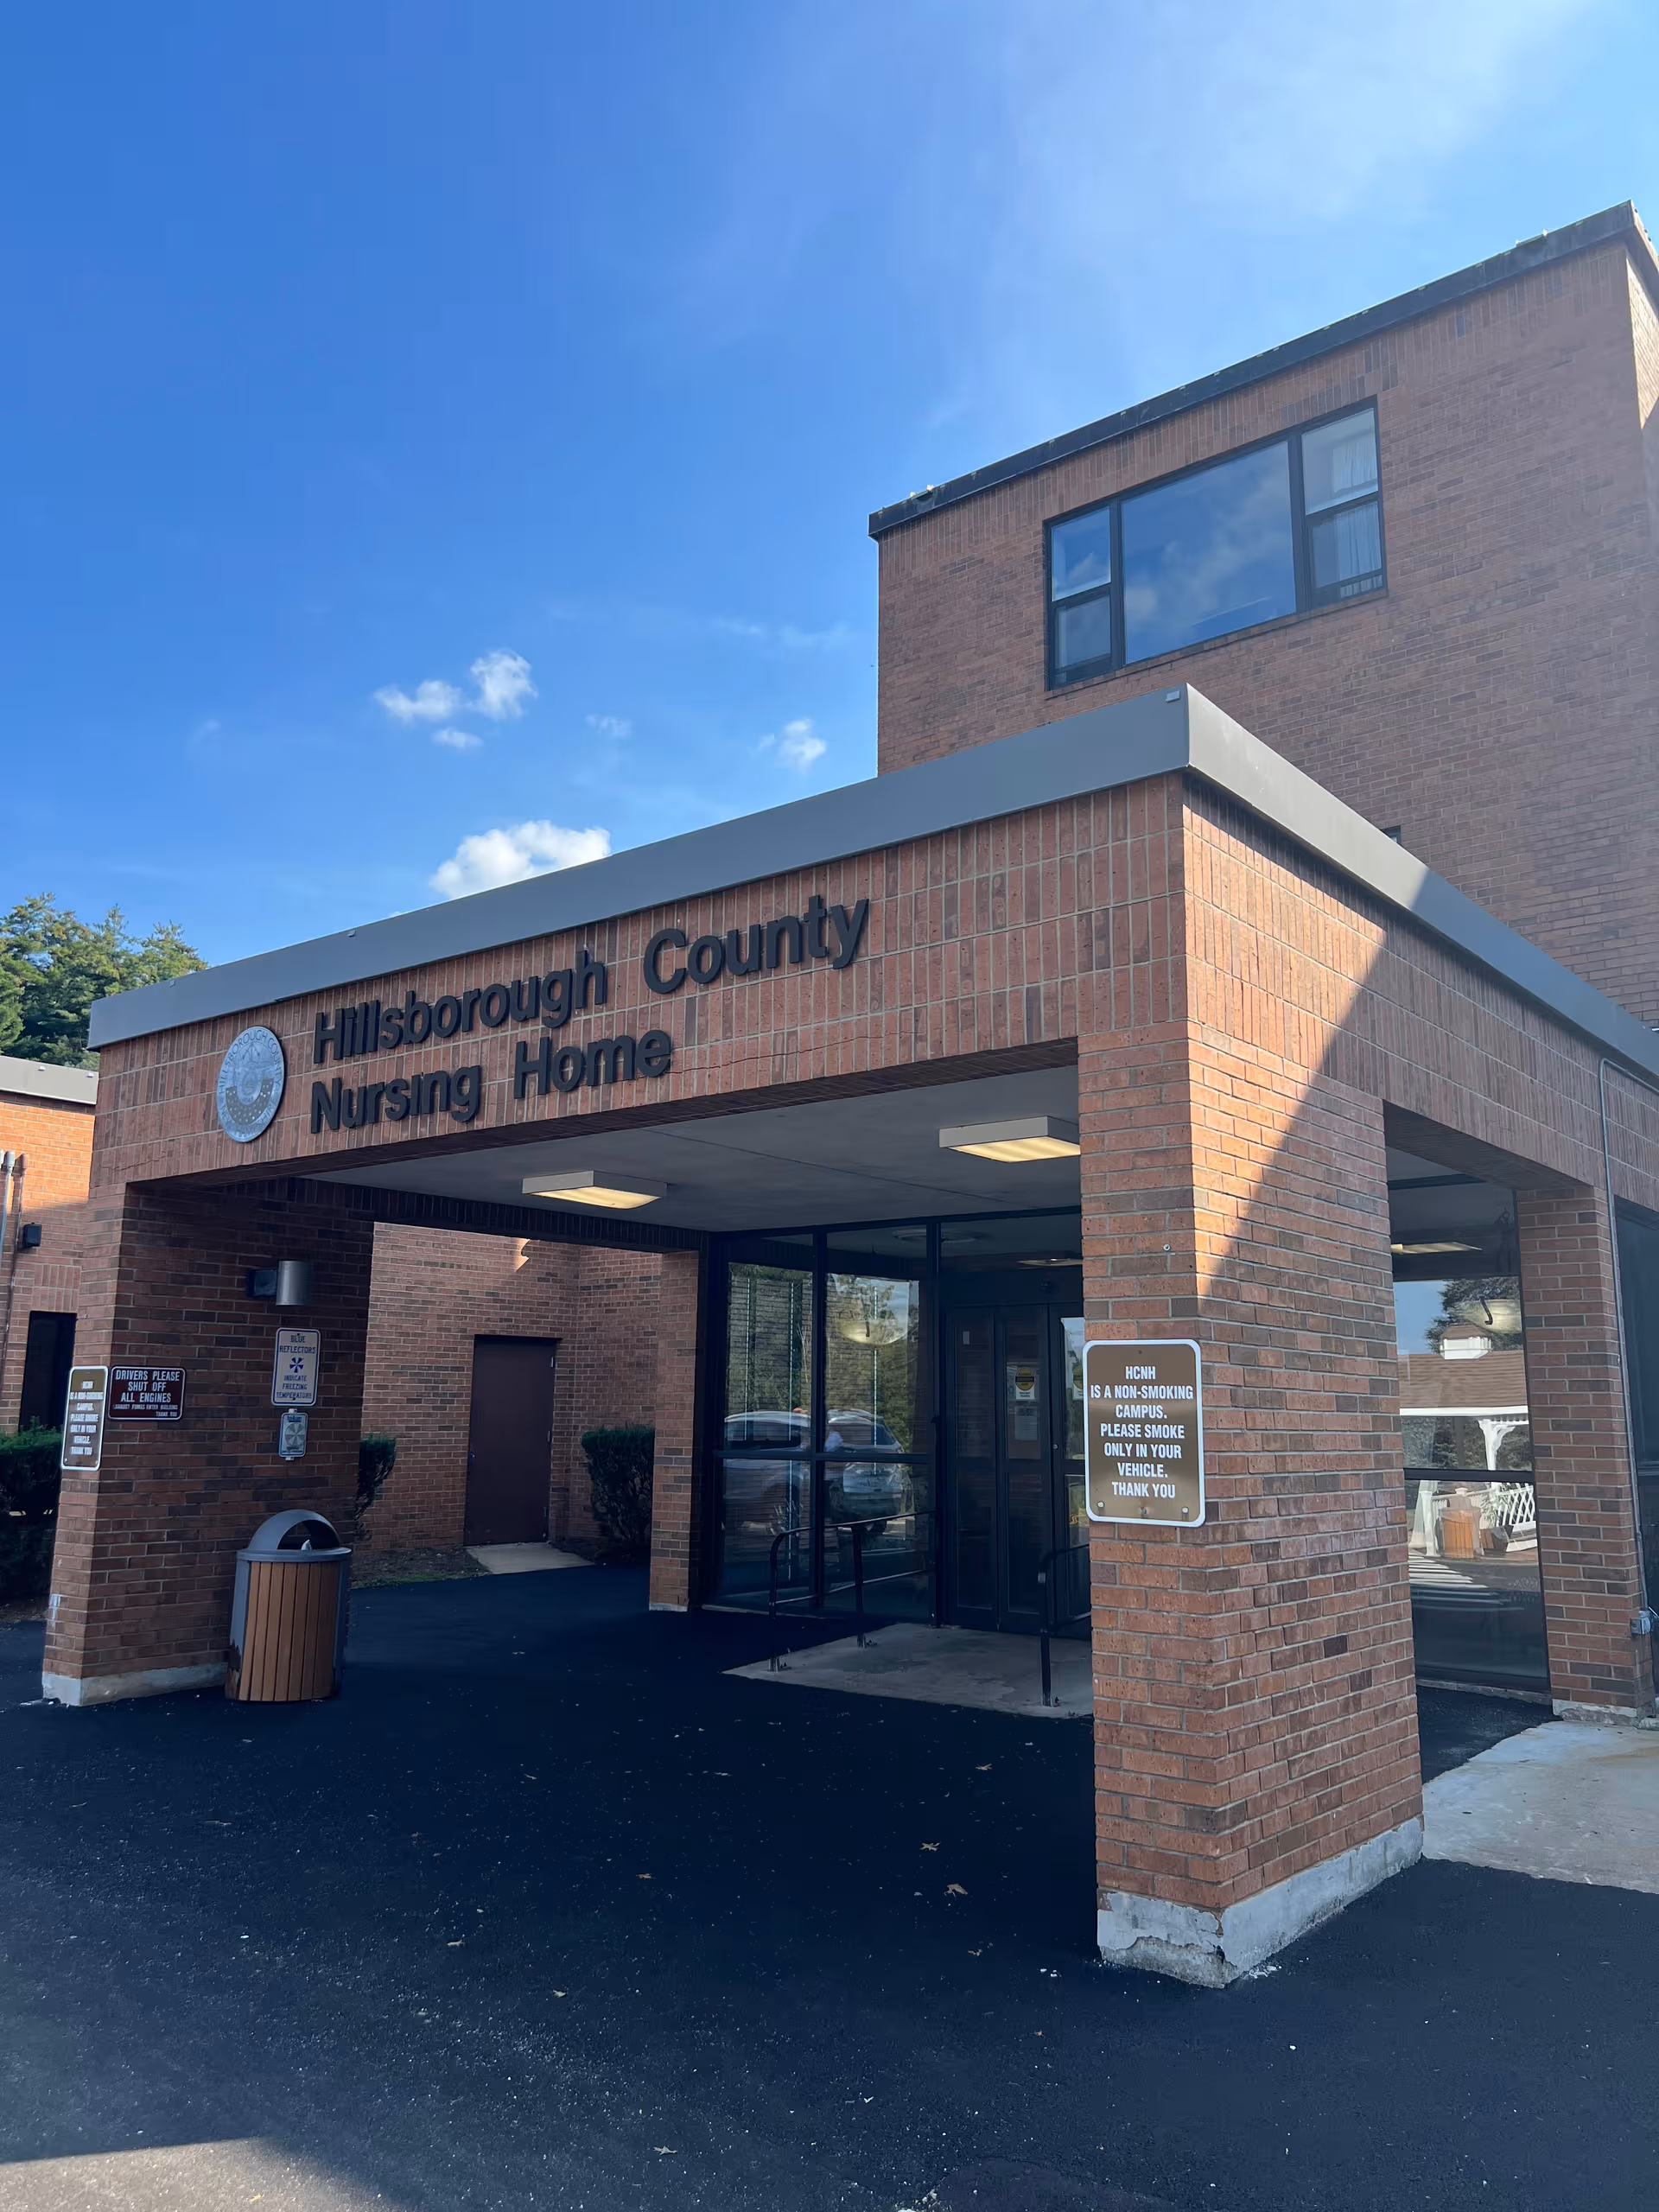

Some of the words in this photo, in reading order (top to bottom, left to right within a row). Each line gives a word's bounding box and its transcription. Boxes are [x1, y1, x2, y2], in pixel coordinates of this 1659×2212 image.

[313, 950, 607, 1065] Hillsborough
[643, 894, 869, 995] County
[219, 1029, 268, 1094] HILLSBOROUGH
[267, 1037, 282, 1087] COUNTY
[310, 1064, 481, 1135] Nursing
[513, 1028, 672, 1100] Home
[290, 1335, 306, 1344] BLUE
[279, 1344, 316, 1354] REFLECTORS
[116, 1370, 149, 1381] DRIVERS
[152, 1370, 181, 1382] PLEASE
[1125, 1365, 1156, 1380] HCNH
[128, 1382, 149, 1392] SHUT
[153, 1382, 167, 1392] OFF
[1090, 1385, 1101, 1398] IS
[1104, 1385, 1112, 1399] A
[1114, 1385, 1194, 1400] NON-SMOKING
[121, 1392, 135, 1402] ALL
[139, 1393, 172, 1403] ENGINES
[1116, 1404, 1167, 1419] CAMPUS.
[1100, 1423, 1141, 1438] PLEASE
[1144, 1425, 1185, 1439] SMOKE
[1104, 1442, 1134, 1458] ONLY
[1135, 1443, 1148, 1458] IN
[1150, 1444, 1182, 1459] YOUR
[1117, 1462, 1168, 1478] VEHICLE.
[1112, 1482, 1149, 1497] THANK
[1153, 1484, 1176, 1498] YOU
